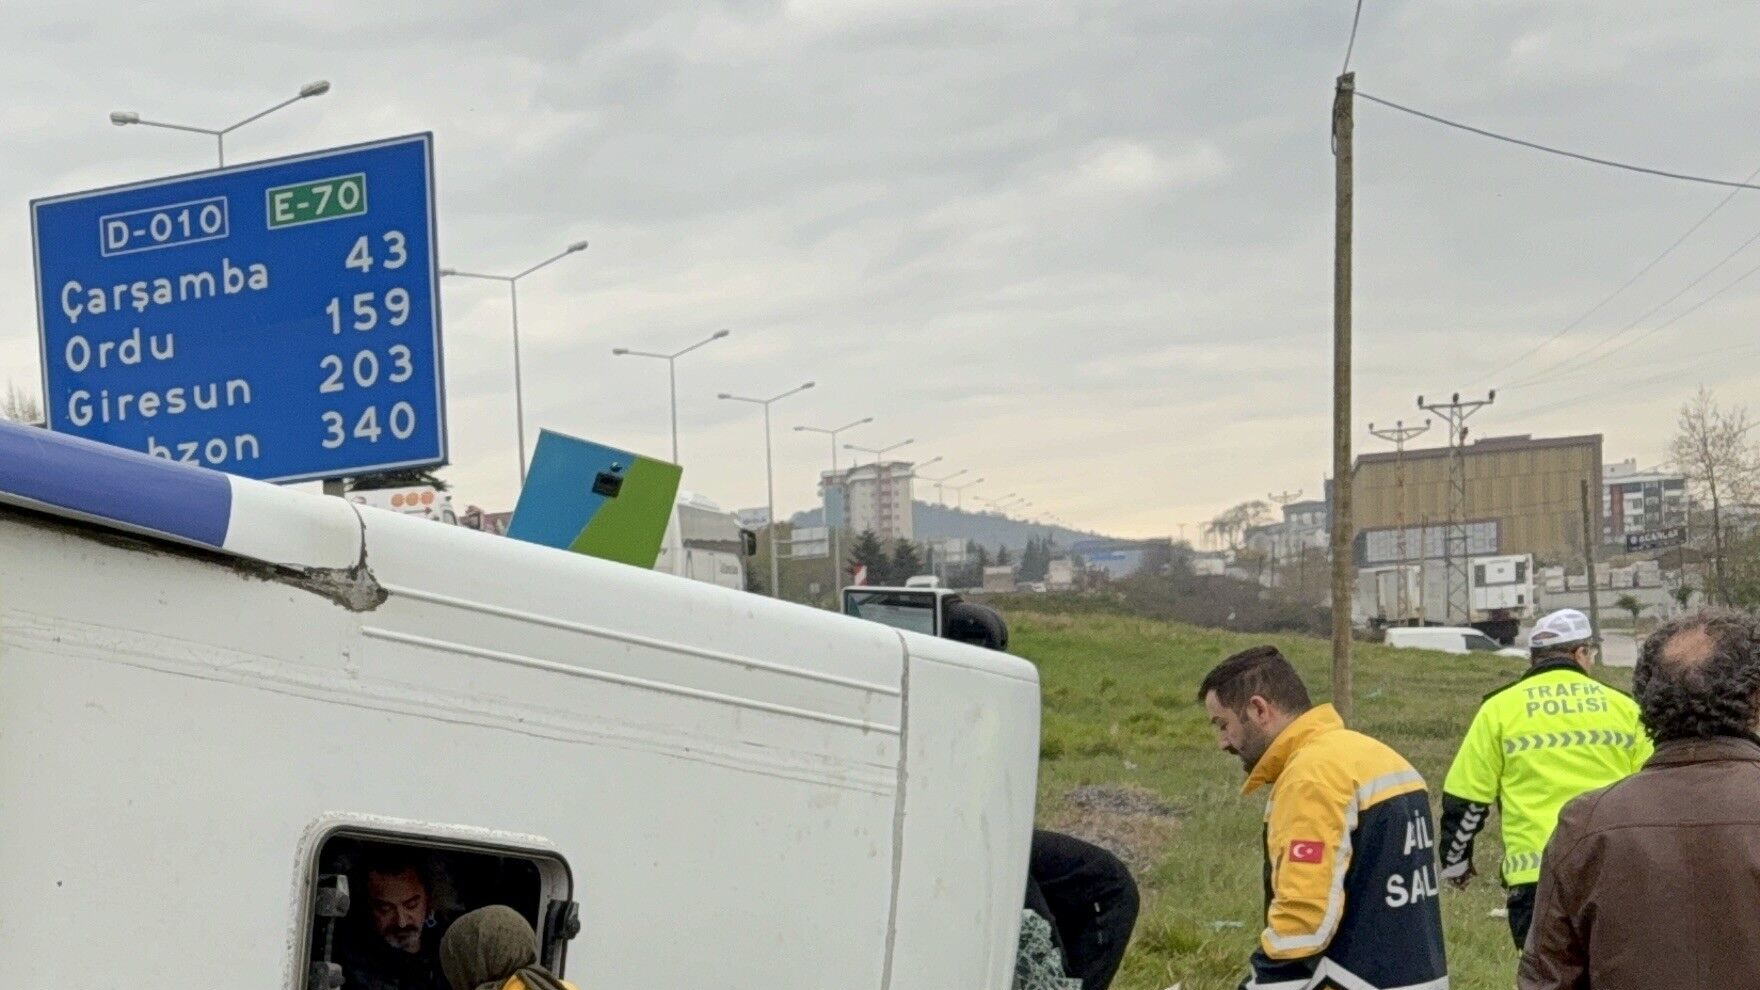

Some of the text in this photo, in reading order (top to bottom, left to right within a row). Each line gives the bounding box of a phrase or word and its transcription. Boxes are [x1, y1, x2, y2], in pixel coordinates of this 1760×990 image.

[274, 181, 360, 221] E-70
[108, 204, 222, 249] D-010
[345, 231, 408, 272] 43
[61, 258, 268, 323] Çarşamba
[326, 287, 411, 334] 159
[65, 328, 175, 372] Ordu
[319, 345, 413, 394] 203
[68, 378, 251, 426] Giresun
[321, 402, 416, 449] 340
[148, 433, 260, 466] bzon
[1523, 683, 1604, 700] TRAFİK
[1526, 697, 1608, 718] POLİSİ
